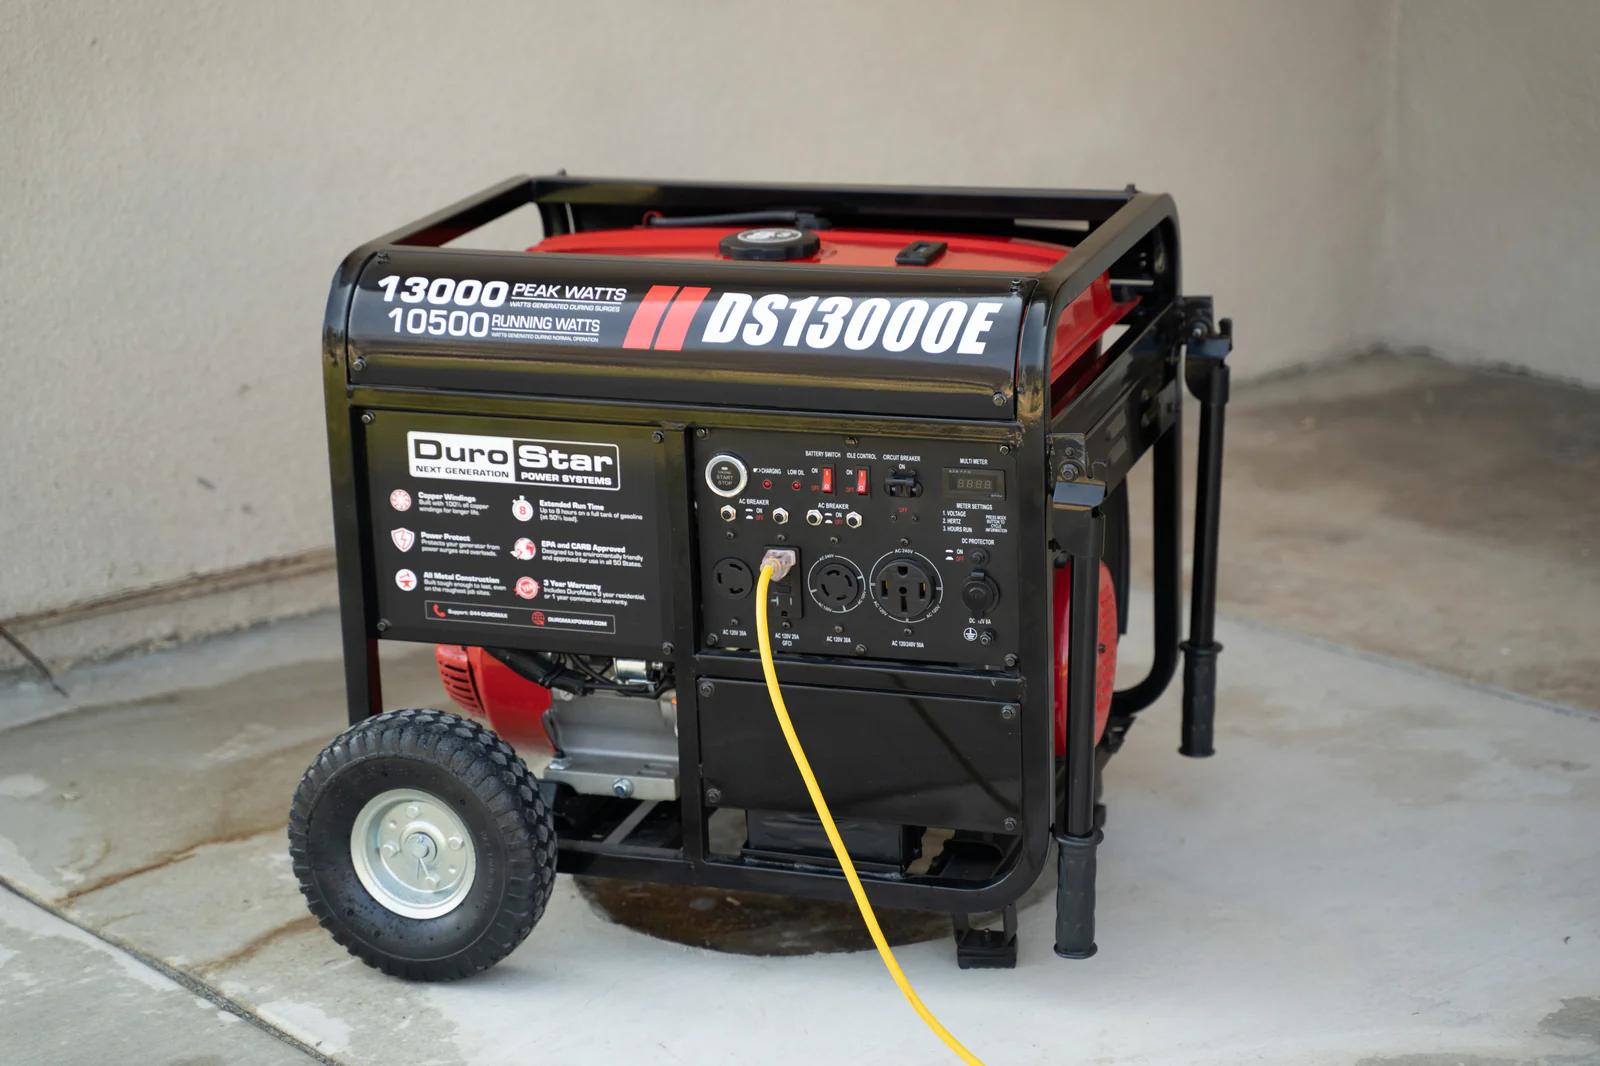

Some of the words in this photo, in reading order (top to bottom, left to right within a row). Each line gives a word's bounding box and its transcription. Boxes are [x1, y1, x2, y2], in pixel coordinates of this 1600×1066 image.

[378, 275, 509, 308] 13000
[512, 283, 561, 298] PEAK
[565, 286, 627, 301] WATTS
[388, 308, 490, 337] 10500
[492, 314, 552, 330] RUNNING
[555, 318, 600, 332] WATTS
[702, 292, 1003, 354] DS13000E
[414, 439, 508, 465] Duro
[518, 444, 613, 472] Star
[416, 465, 442, 474] NEXT
[445, 467, 509, 478] GENERATION
[521, 472, 560, 482] POWER
[562, 474, 612, 486] SYSTEMS
[418, 492, 443, 500] Copper
[444, 494, 476, 503] Windings
[540, 500, 571, 508] Extended
[520, 506, 526, 515] 8
[444, 533, 470, 541] Protect
[541, 540, 556, 548] EPA
[593, 544, 625, 554] Approved
[455, 574, 500, 584] Construction
[567, 581, 601, 591] Warranty
[548, 617, 607, 626] DUROMAXPOWER.COM
